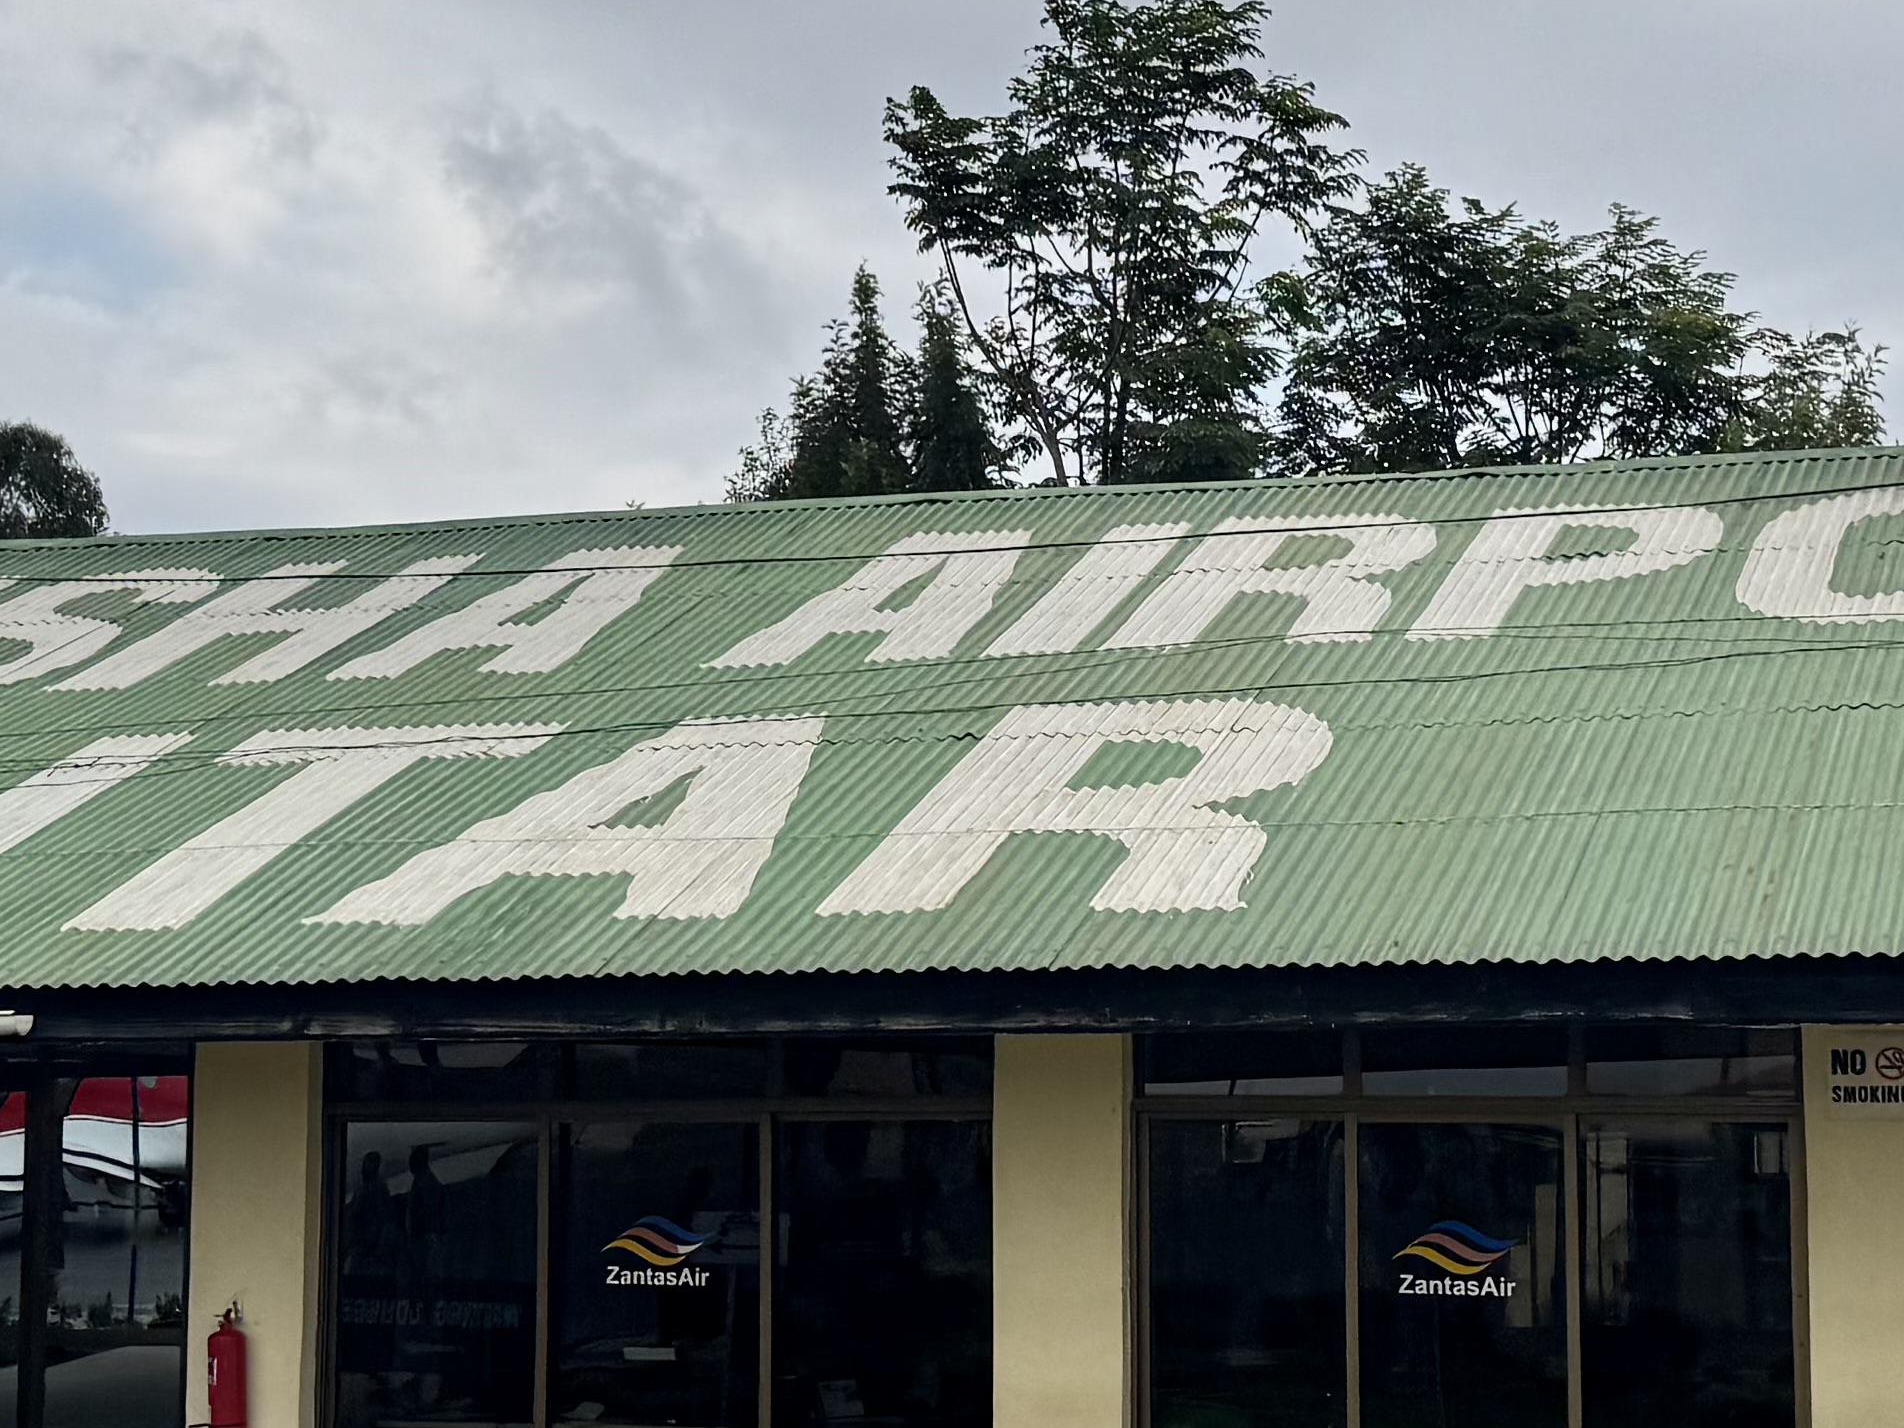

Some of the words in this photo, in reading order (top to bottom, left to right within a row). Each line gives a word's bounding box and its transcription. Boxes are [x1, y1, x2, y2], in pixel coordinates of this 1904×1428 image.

[1831, 1049, 1866, 1075] NO
[606, 1266, 711, 1287] ZantasAir
[1398, 1274, 1517, 1298] ZantasAir
